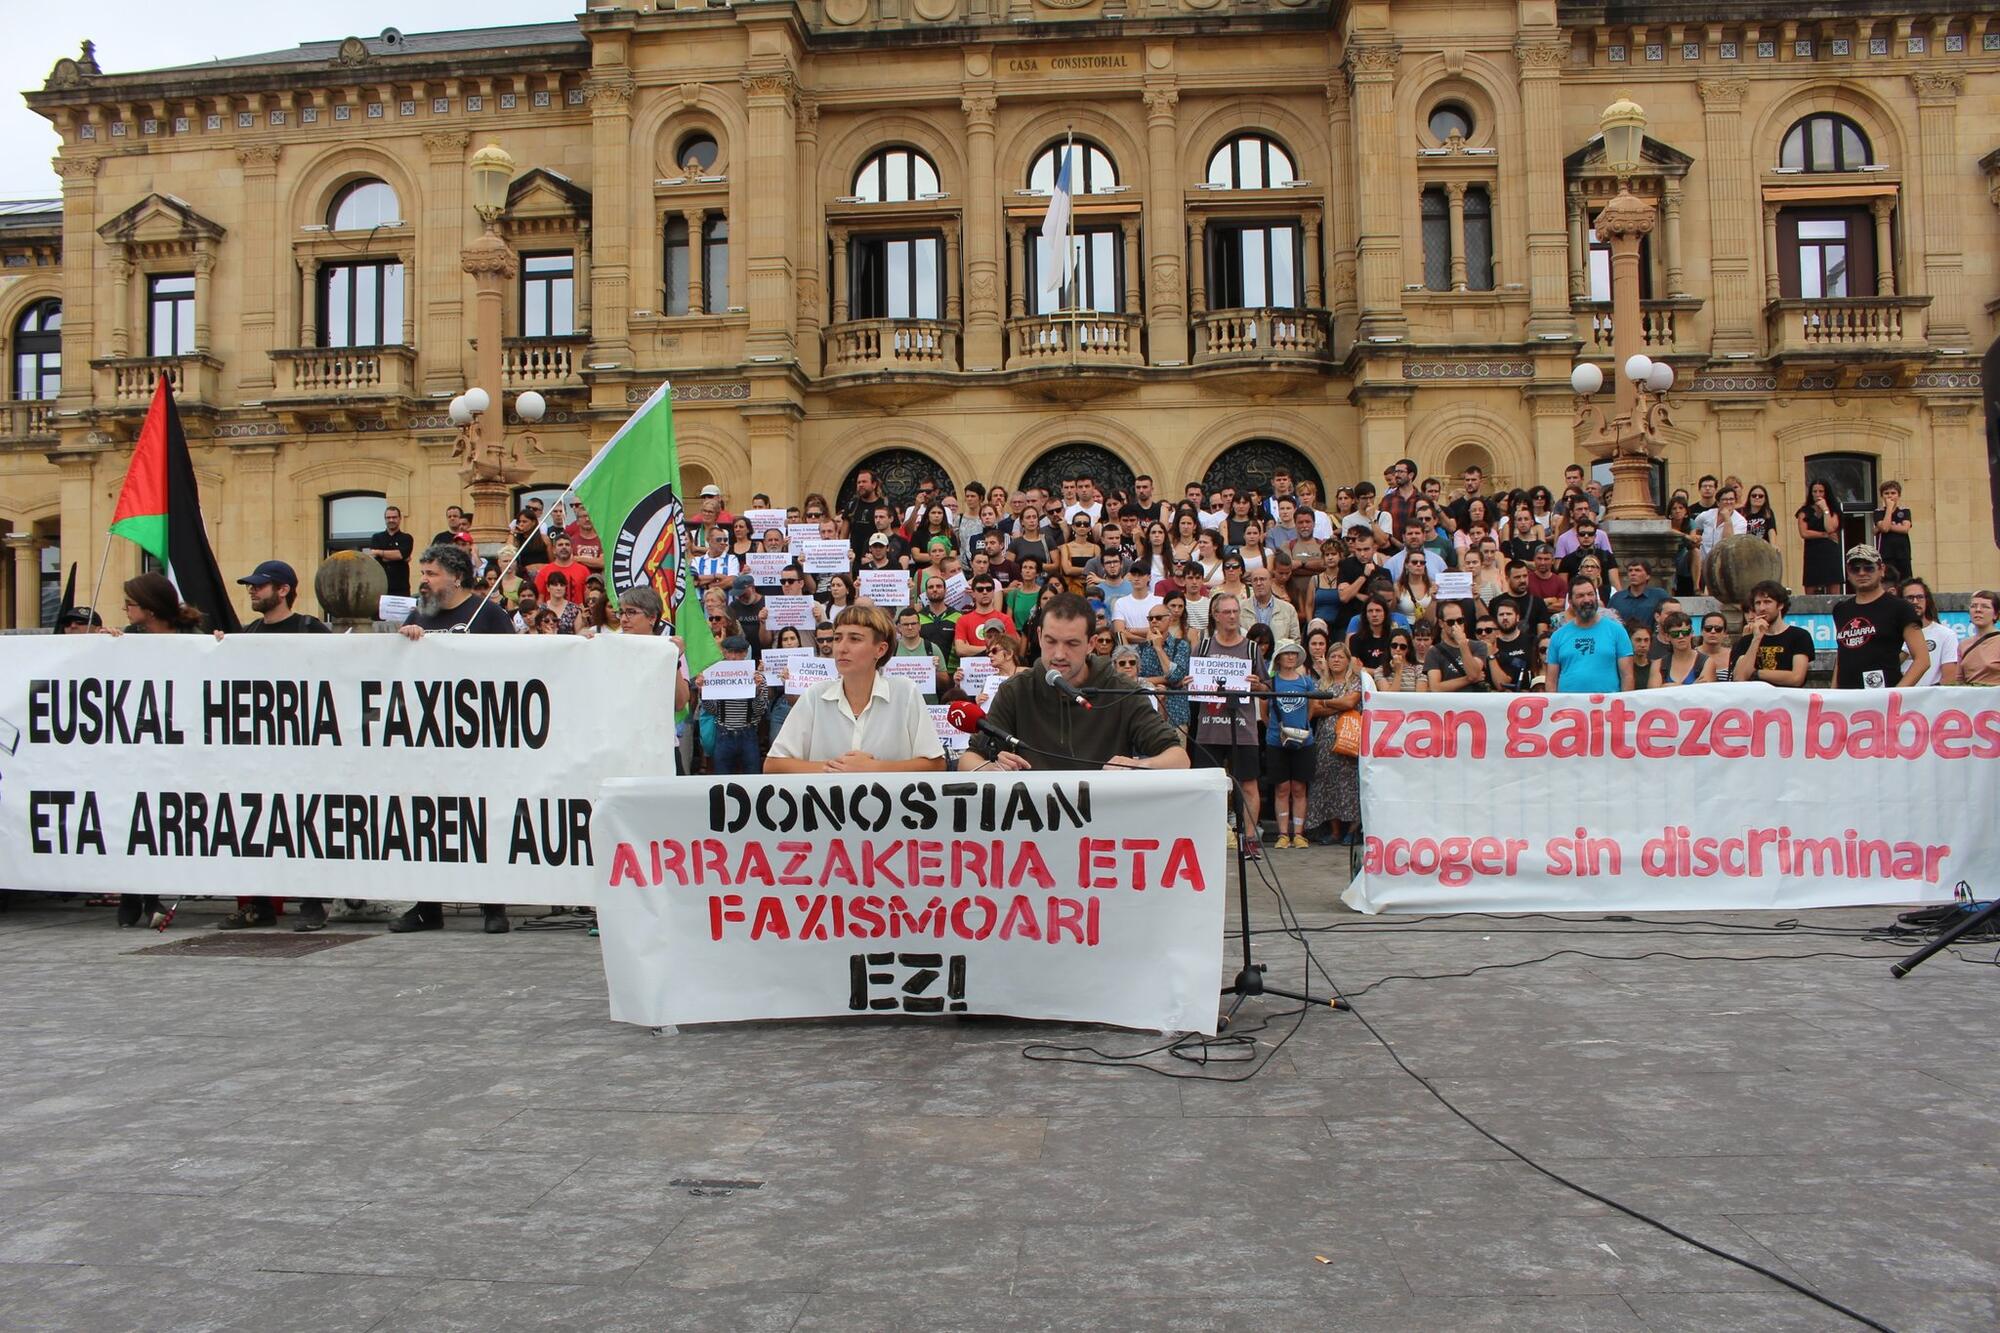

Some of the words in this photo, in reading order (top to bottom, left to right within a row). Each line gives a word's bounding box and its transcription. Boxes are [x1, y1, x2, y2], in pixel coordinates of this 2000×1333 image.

[1009, 59, 1038, 72] CASA
[1051, 55, 1128, 70] CONSISTORIAL
[762, 576, 777, 585] EZ!
[1837, 625, 1876, 640] ALPUJARRA
[1845, 636, 1865, 647] LIBRE
[801, 662, 826, 670] LUCHA
[1206, 661, 1247, 669] DONOSTIA
[1207, 668, 1245, 676] DECIMOS
[29, 677, 184, 745] EUSKAL
[203, 680, 342, 747] HERRIA
[360, 678, 550, 750] FAXISMO
[1361, 691, 1487, 760] izan
[1504, 694, 1794, 760] gaitezen
[1804, 692, 2000, 761] babes
[939, 738, 953, 748] Z!
[708, 781, 1093, 834] DONOSTIAN
[29, 790, 107, 855] ETA
[126, 791, 488, 864] ARRAZAKERIAREN
[609, 838, 1057, 890] ARRAZAKERIA
[1077, 835, 1206, 893] ETA
[1362, 835, 1528, 888] acoger
[1546, 827, 1622, 877] sin
[1641, 825, 1951, 884] discriminar
[708, 893, 1101, 947] FAXISMOARI
[848, 952, 968, 1013] EZ!
